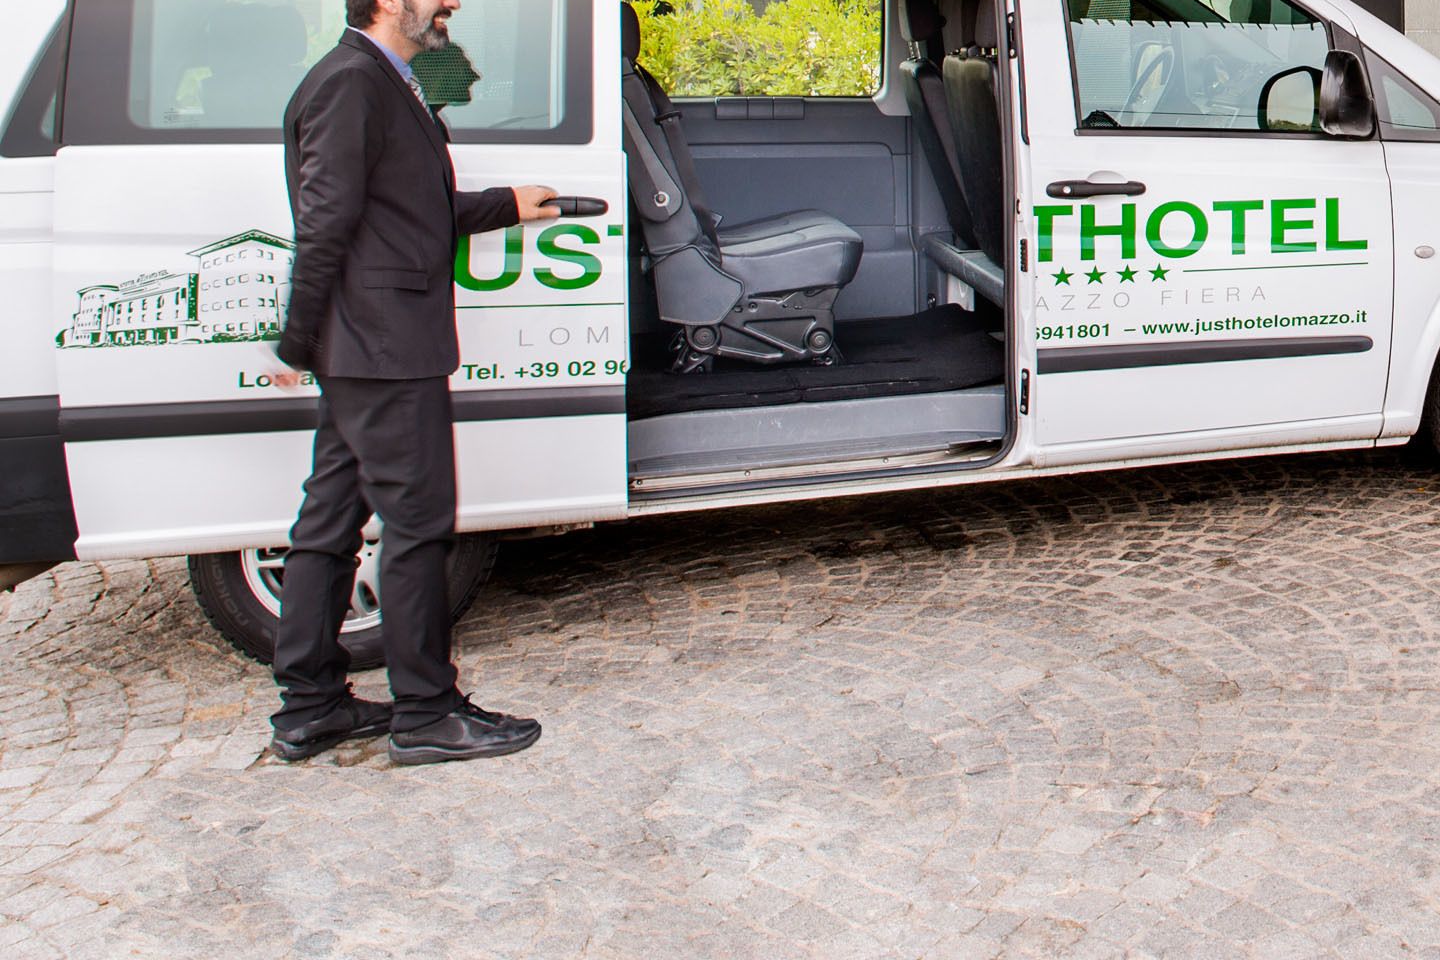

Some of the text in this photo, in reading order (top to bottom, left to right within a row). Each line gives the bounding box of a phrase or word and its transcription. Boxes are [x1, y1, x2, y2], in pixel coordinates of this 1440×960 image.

[1160, 285, 1267, 307] FIERA
[462, 363, 505, 380] Tel.
[514, 361, 559, 379] +39
[567, 360, 596, 377] 02
[1142, 309, 1368, 336] www.justhotelomazzo.it
